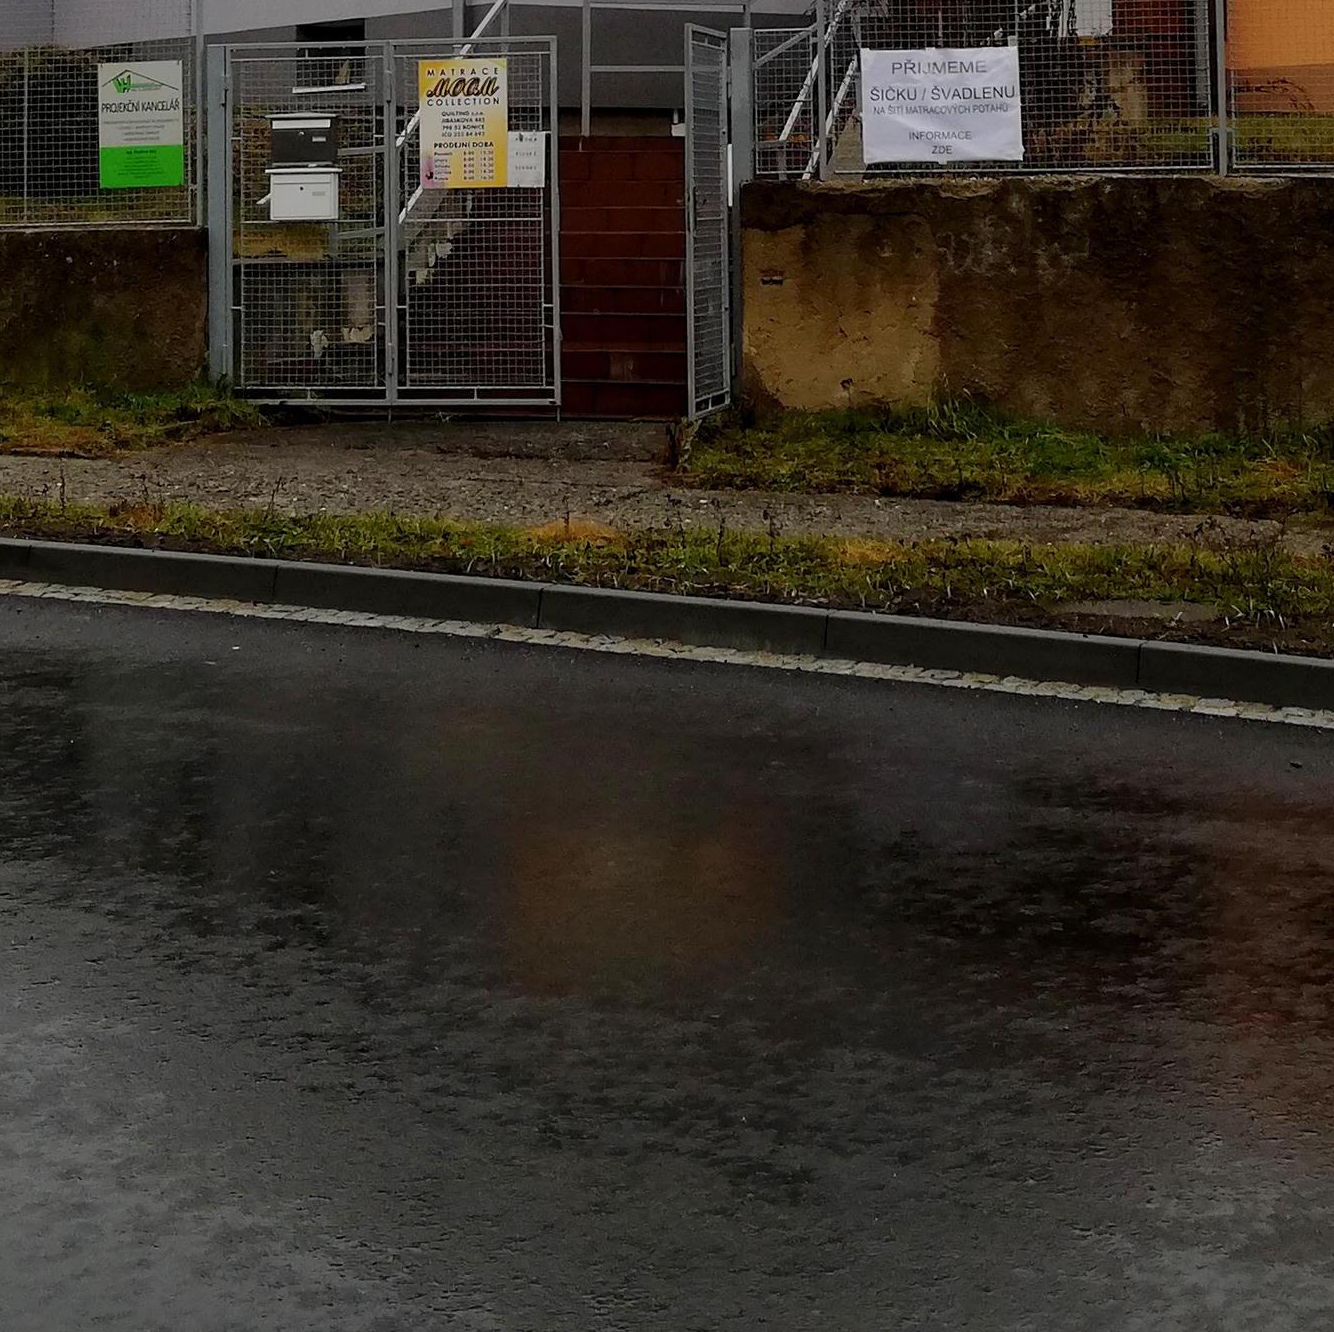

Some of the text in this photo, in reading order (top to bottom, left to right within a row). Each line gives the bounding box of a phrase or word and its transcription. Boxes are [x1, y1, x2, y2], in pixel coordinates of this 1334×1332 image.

[891, 59, 988, 75] PŘIJMEME
[427, 68, 500, 77] MATRACE
[869, 85, 917, 102] ŠIČKU
[930, 85, 1016, 101] ŠVADLENU
[101, 97, 180, 113] PROJEKČNÍ KANCELÁŘ
[426, 97, 500, 107] COLLECTION
[908, 131, 972, 141] INFORMACE
[931, 145, 954, 155] ZDE
